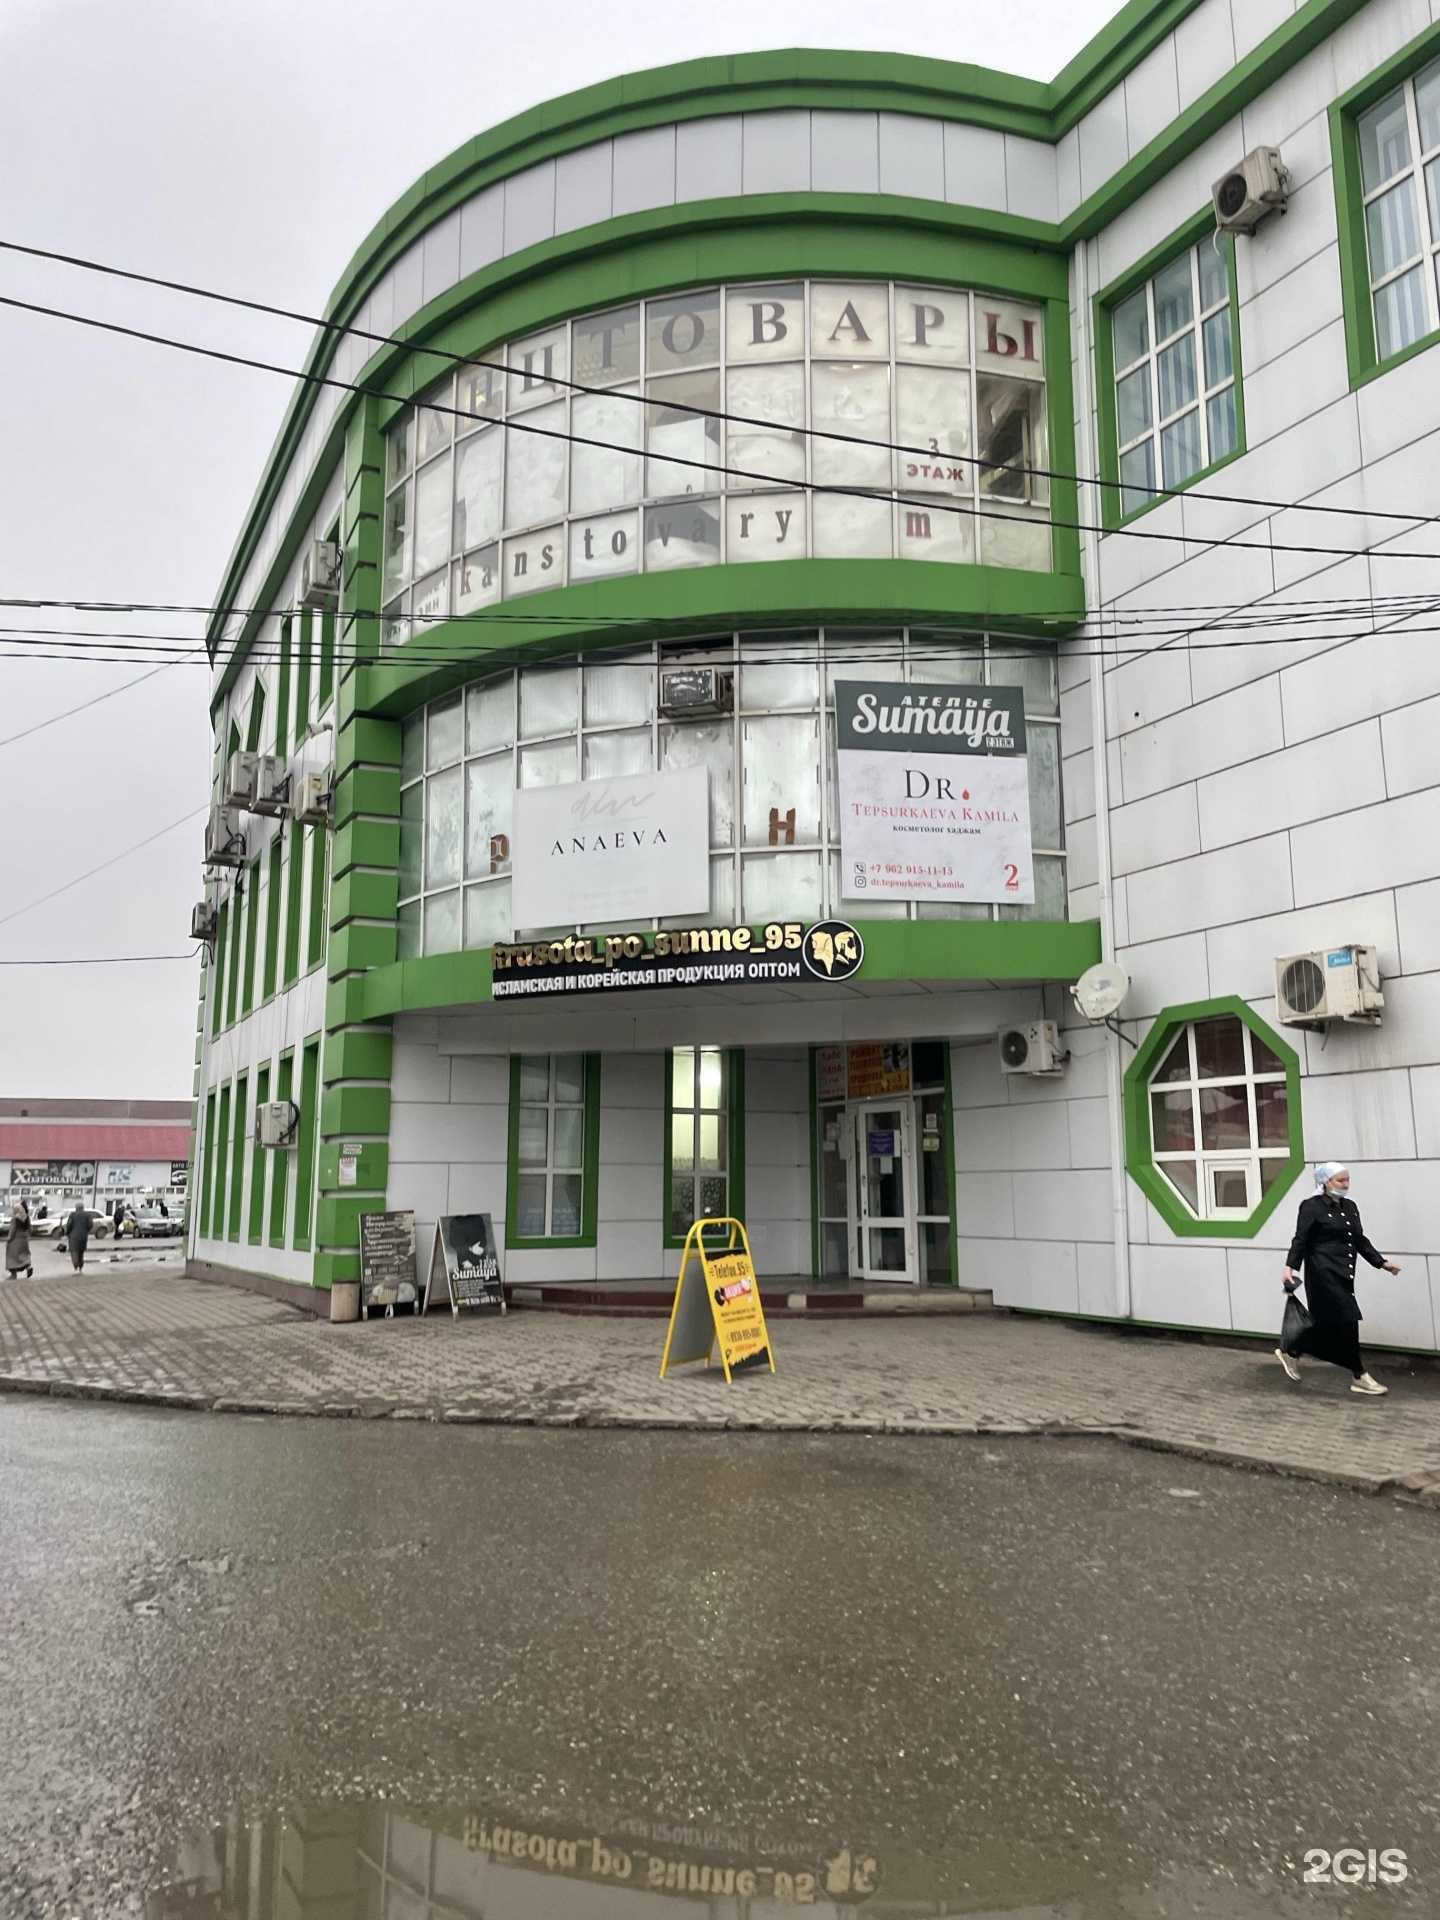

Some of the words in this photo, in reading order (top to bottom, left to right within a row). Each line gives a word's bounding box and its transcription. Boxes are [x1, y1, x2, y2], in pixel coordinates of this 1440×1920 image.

[907, 464, 965, 481] ЭТАЖ
[901, 695, 993, 708] АТЕЛЬЕ
[852, 694, 1010, 748] Sumaya
[551, 828, 668, 856] ANAEVA
[1003, 864, 1019, 888] 2
[491, 923, 803, 970] krasota_po_sunne_95
[492, 977, 564, 997] ИСЛАМСКАЯ
[564, 975, 577, 991] И
[577, 968, 656, 990] КОРЕЙСКАЯ
[657, 963, 745, 984] ПРОДУКЦИЯ
[748, 962, 801, 979] ОПТОМ
